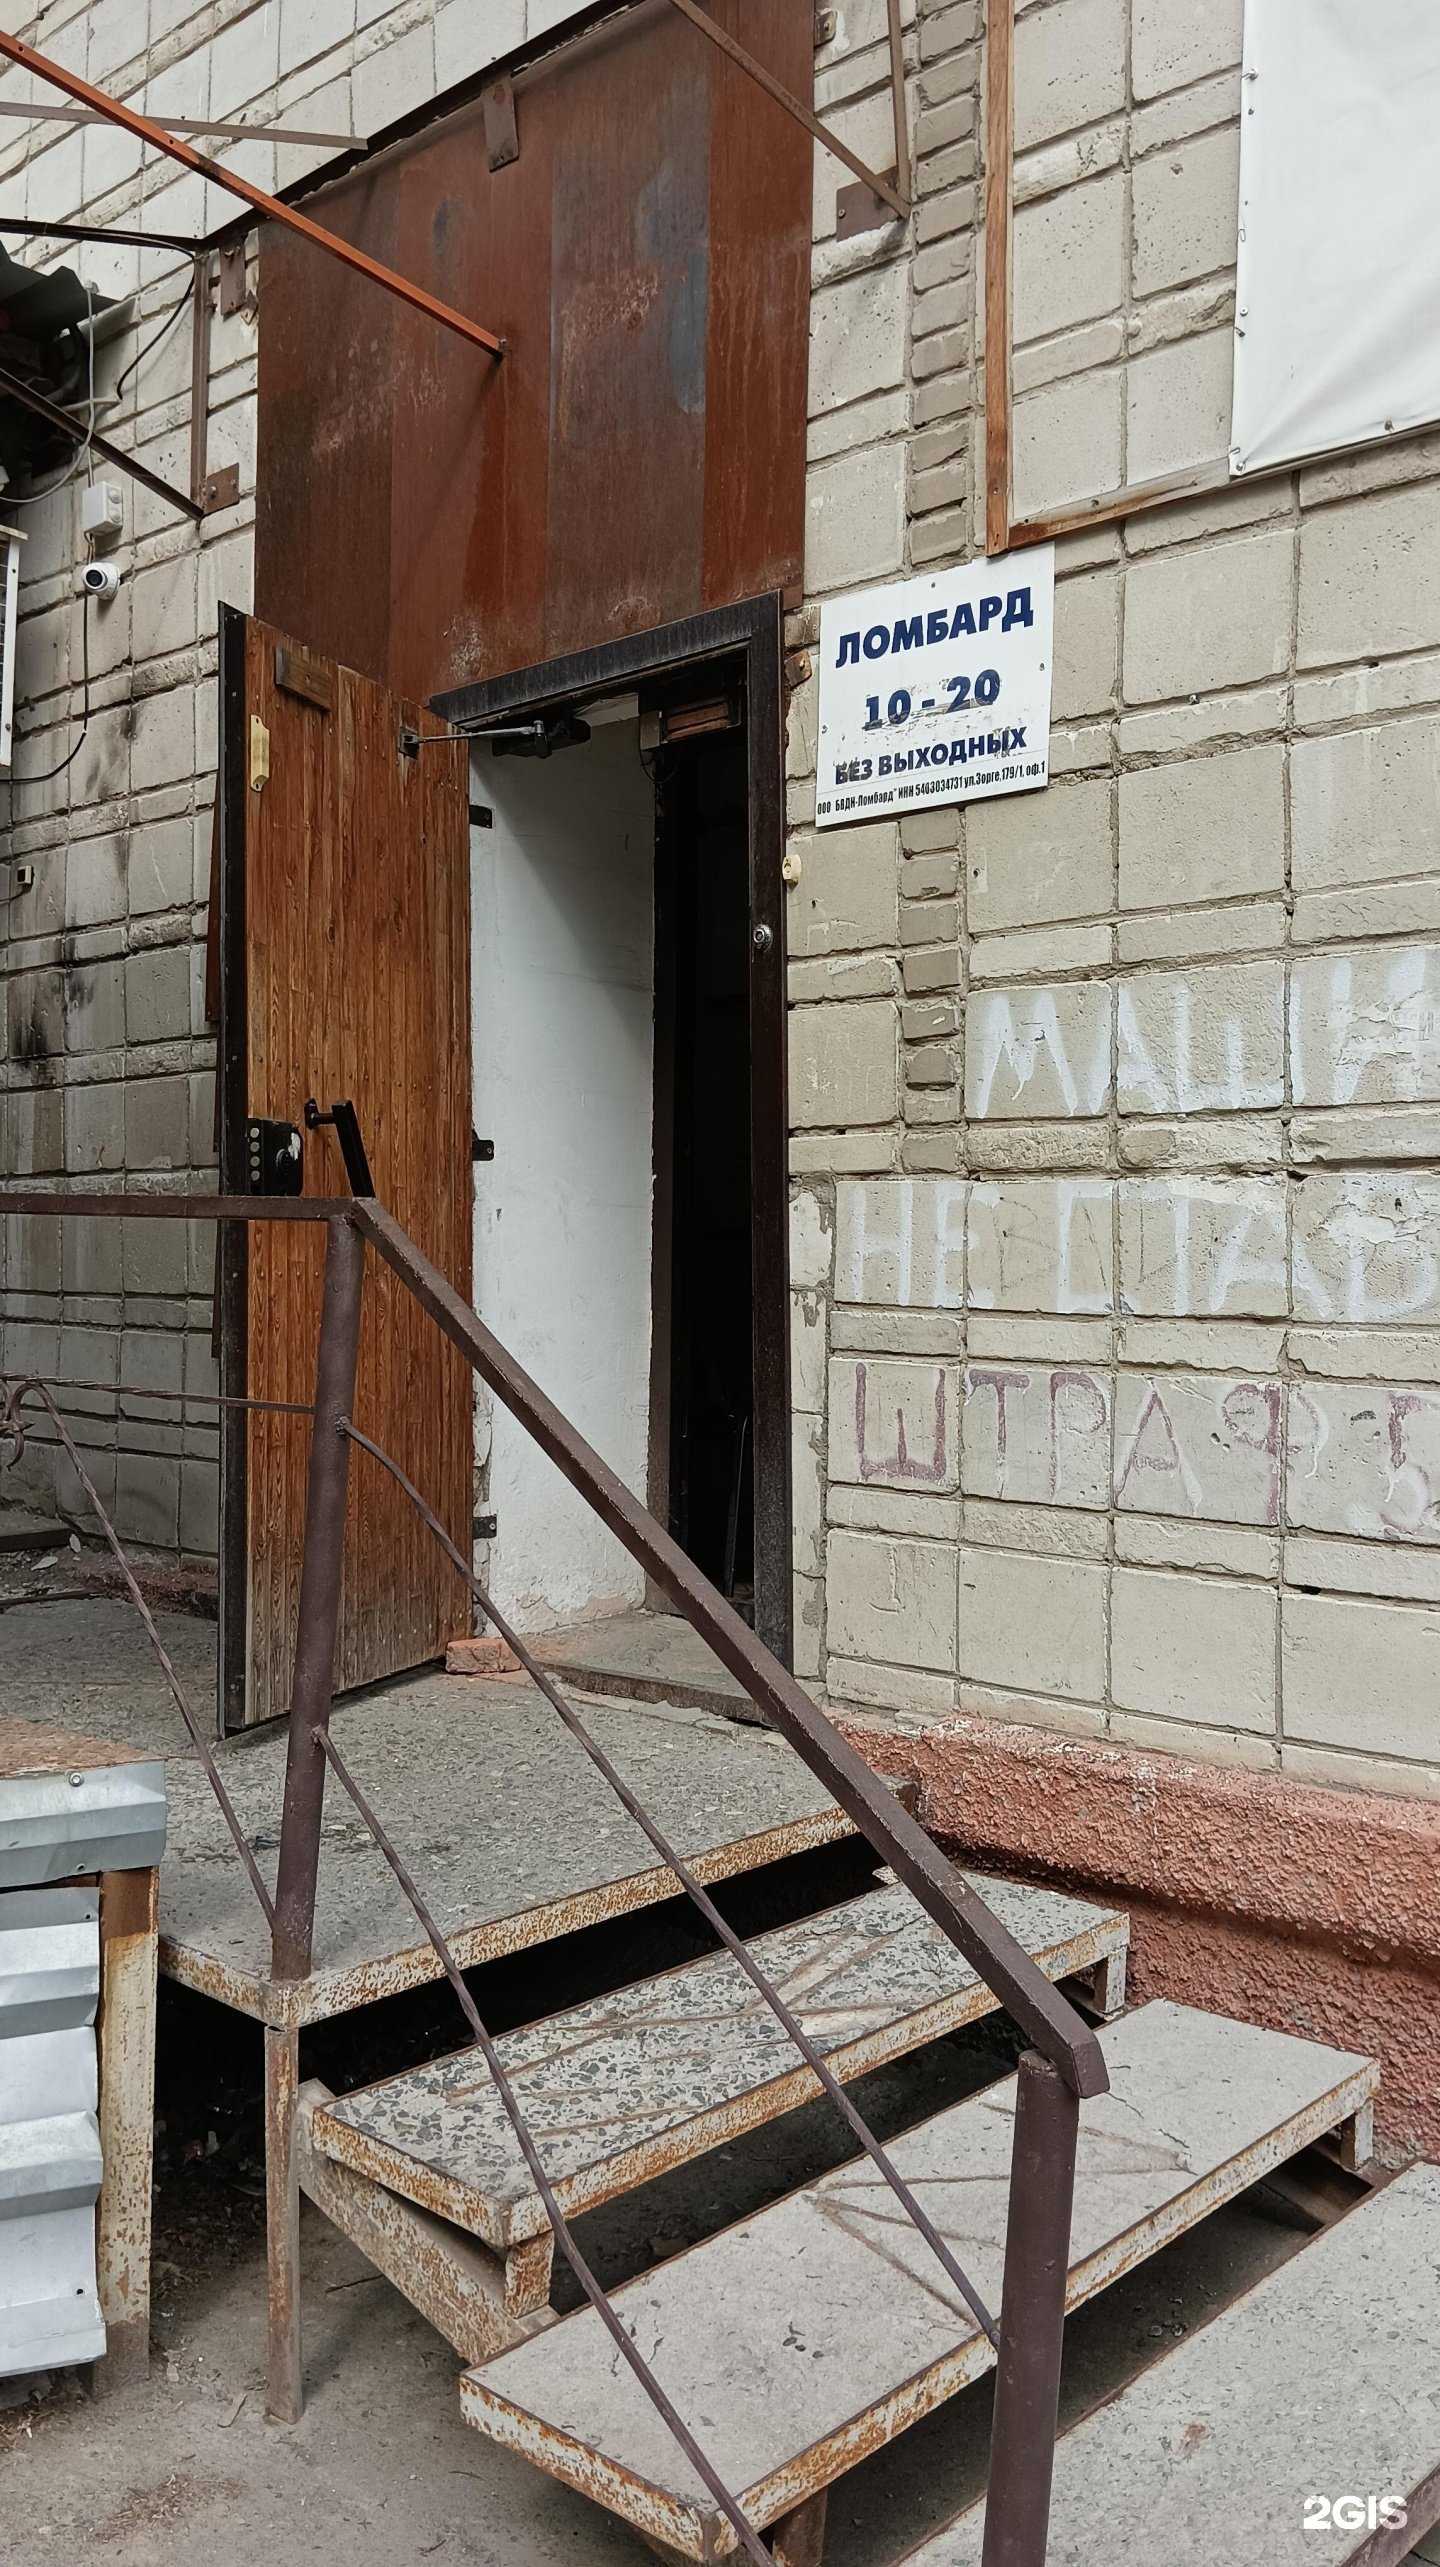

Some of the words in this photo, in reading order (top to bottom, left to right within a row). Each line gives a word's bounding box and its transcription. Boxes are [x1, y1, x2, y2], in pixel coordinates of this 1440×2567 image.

[836, 587, 1034, 668] ЛОМБАРД
[835, 758, 873, 785] БЕЗ
[878, 727, 1027, 776] ВЫХОДНЫХ
[817, 801, 831, 815] ООО
[898, 784, 914, 799] ИНН
[849, 1181, 995, 1309] НЕ
[856, 1362, 1330, 1524] ШТРАФ
